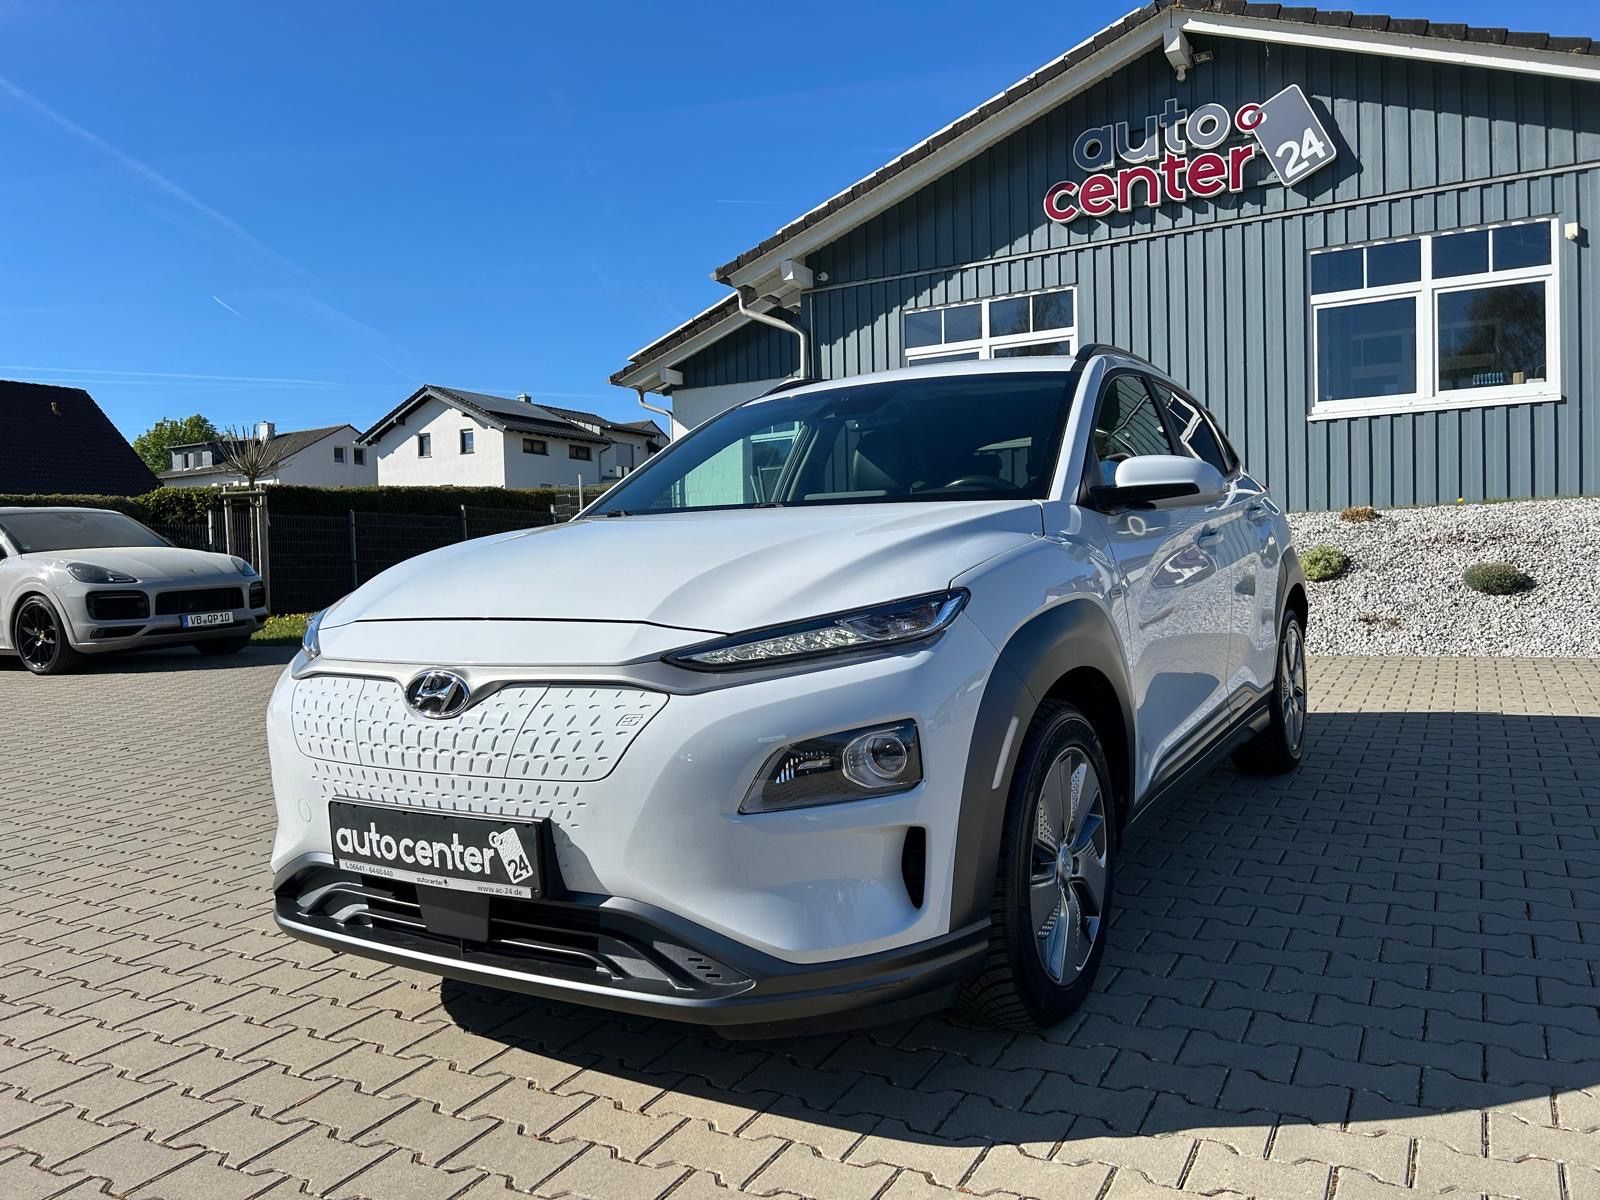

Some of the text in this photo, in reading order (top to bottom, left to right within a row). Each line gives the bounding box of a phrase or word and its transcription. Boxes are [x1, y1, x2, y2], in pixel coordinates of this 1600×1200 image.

[1073, 98, 1231, 172] auto
[1275, 127, 1325, 179] 24
[1043, 145, 1255, 223] center
[190, 613, 230, 625] VB QP 10
[507, 854, 530, 880] 24
[476, 884, 523, 896] www.ac-24.de
